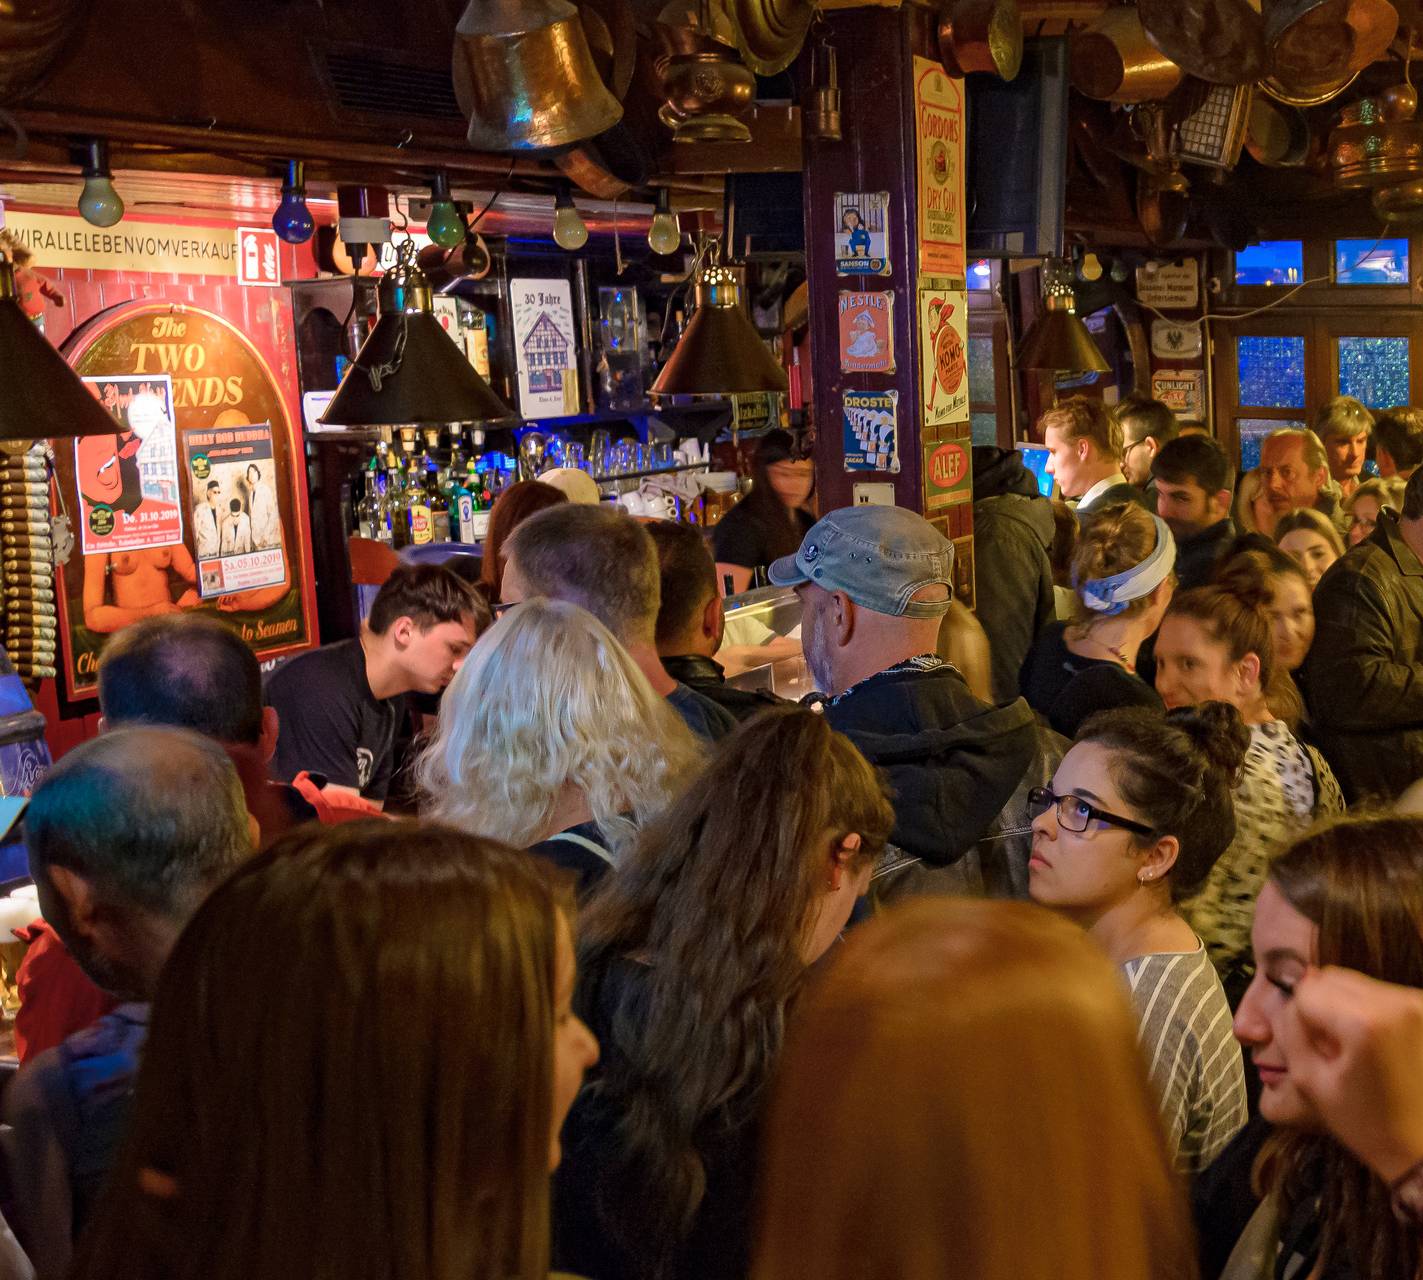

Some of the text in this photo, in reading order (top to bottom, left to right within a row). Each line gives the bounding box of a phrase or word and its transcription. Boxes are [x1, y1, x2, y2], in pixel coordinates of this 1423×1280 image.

[840, 260, 869, 268] SAMSON
[524, 292, 561, 306] 30 Jahre
[152, 316, 186, 338] The
[130, 343, 206, 374] TWO
[939, 343, 961, 369] KOMO
[172, 376, 243, 407] ENDS
[1154, 380, 1195, 392] SUNLIGHT
[844, 396, 892, 408] DROSTE
[934, 452, 961, 481] ALEF
[241, 618, 298, 640] to Seamen
